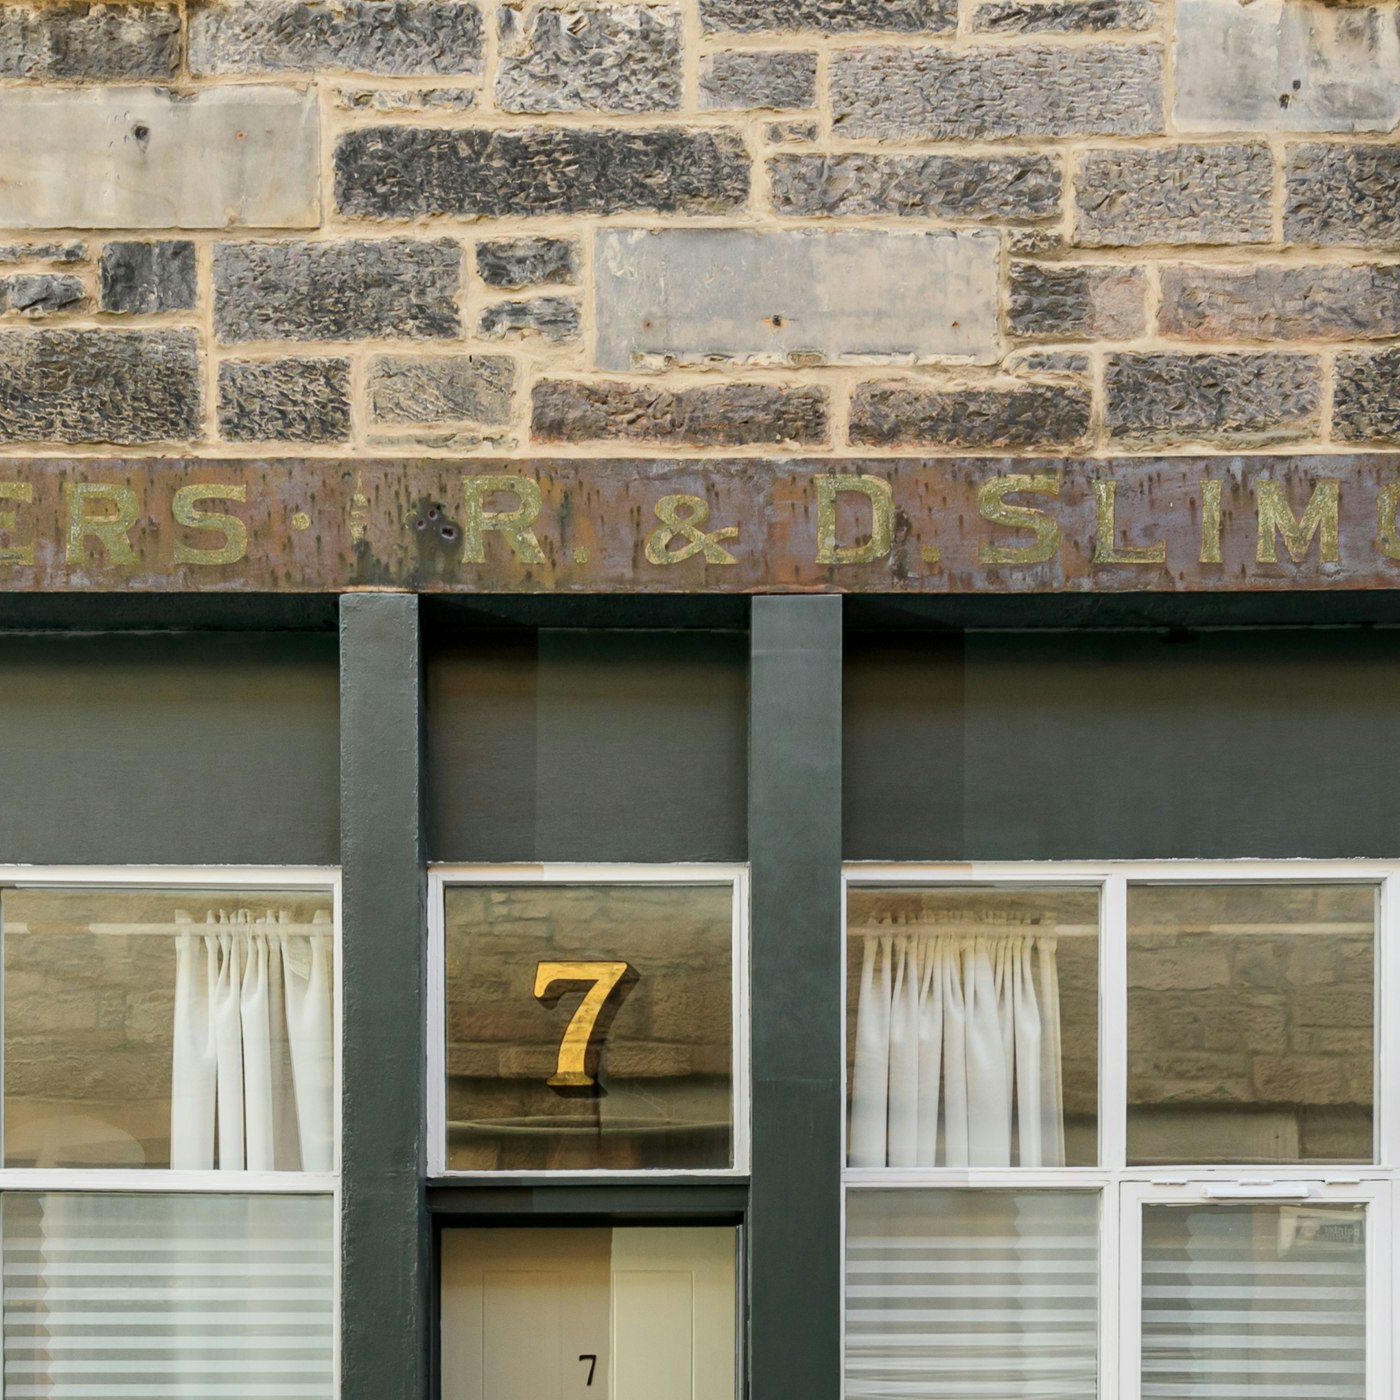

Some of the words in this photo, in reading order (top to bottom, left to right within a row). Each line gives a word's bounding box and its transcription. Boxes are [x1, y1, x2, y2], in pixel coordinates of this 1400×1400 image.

[644, 494, 740, 566] &
[534, 961, 632, 1090] 7
[578, 1354, 597, 1387] 7
